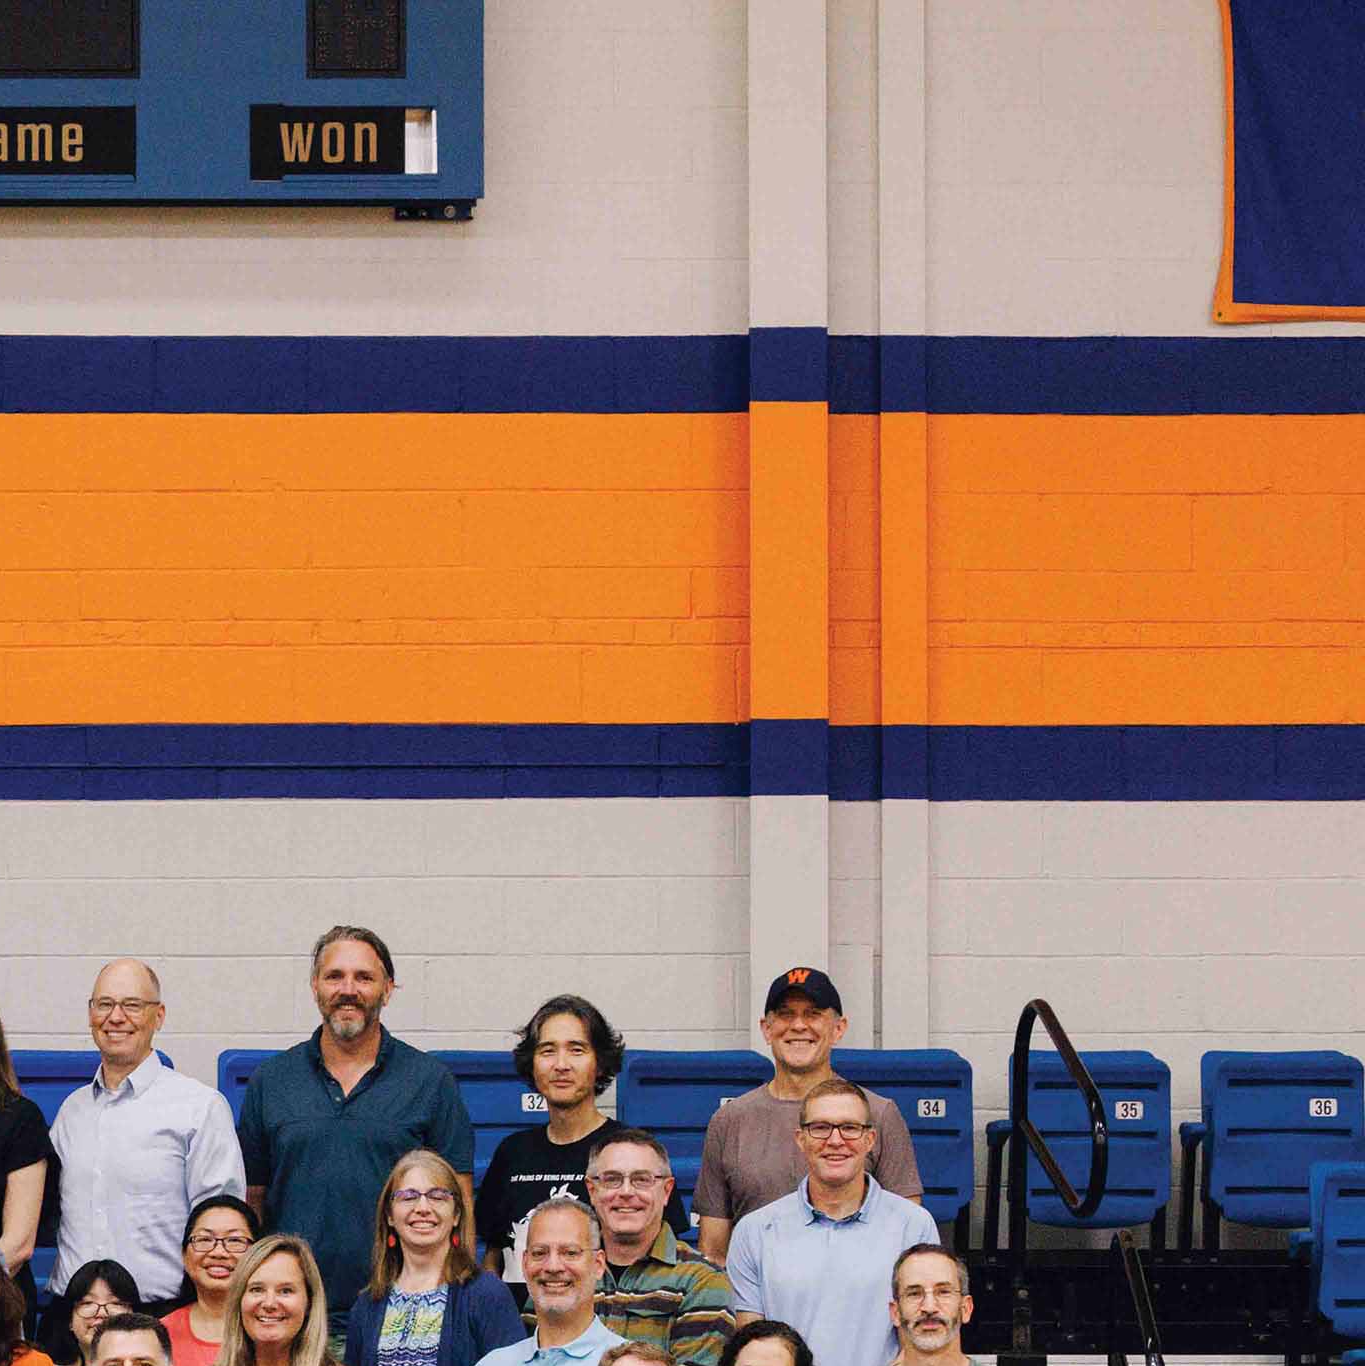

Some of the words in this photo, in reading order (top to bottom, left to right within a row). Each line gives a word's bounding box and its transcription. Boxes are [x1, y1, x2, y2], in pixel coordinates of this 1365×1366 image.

[279, 120, 380, 165] won
[788, 969, 810, 984] W
[527, 1095, 545, 1110] 32
[922, 1100, 941, 1116] 34
[1120, 1101, 1139, 1118] 35
[1314, 1099, 1333, 1115] 36
